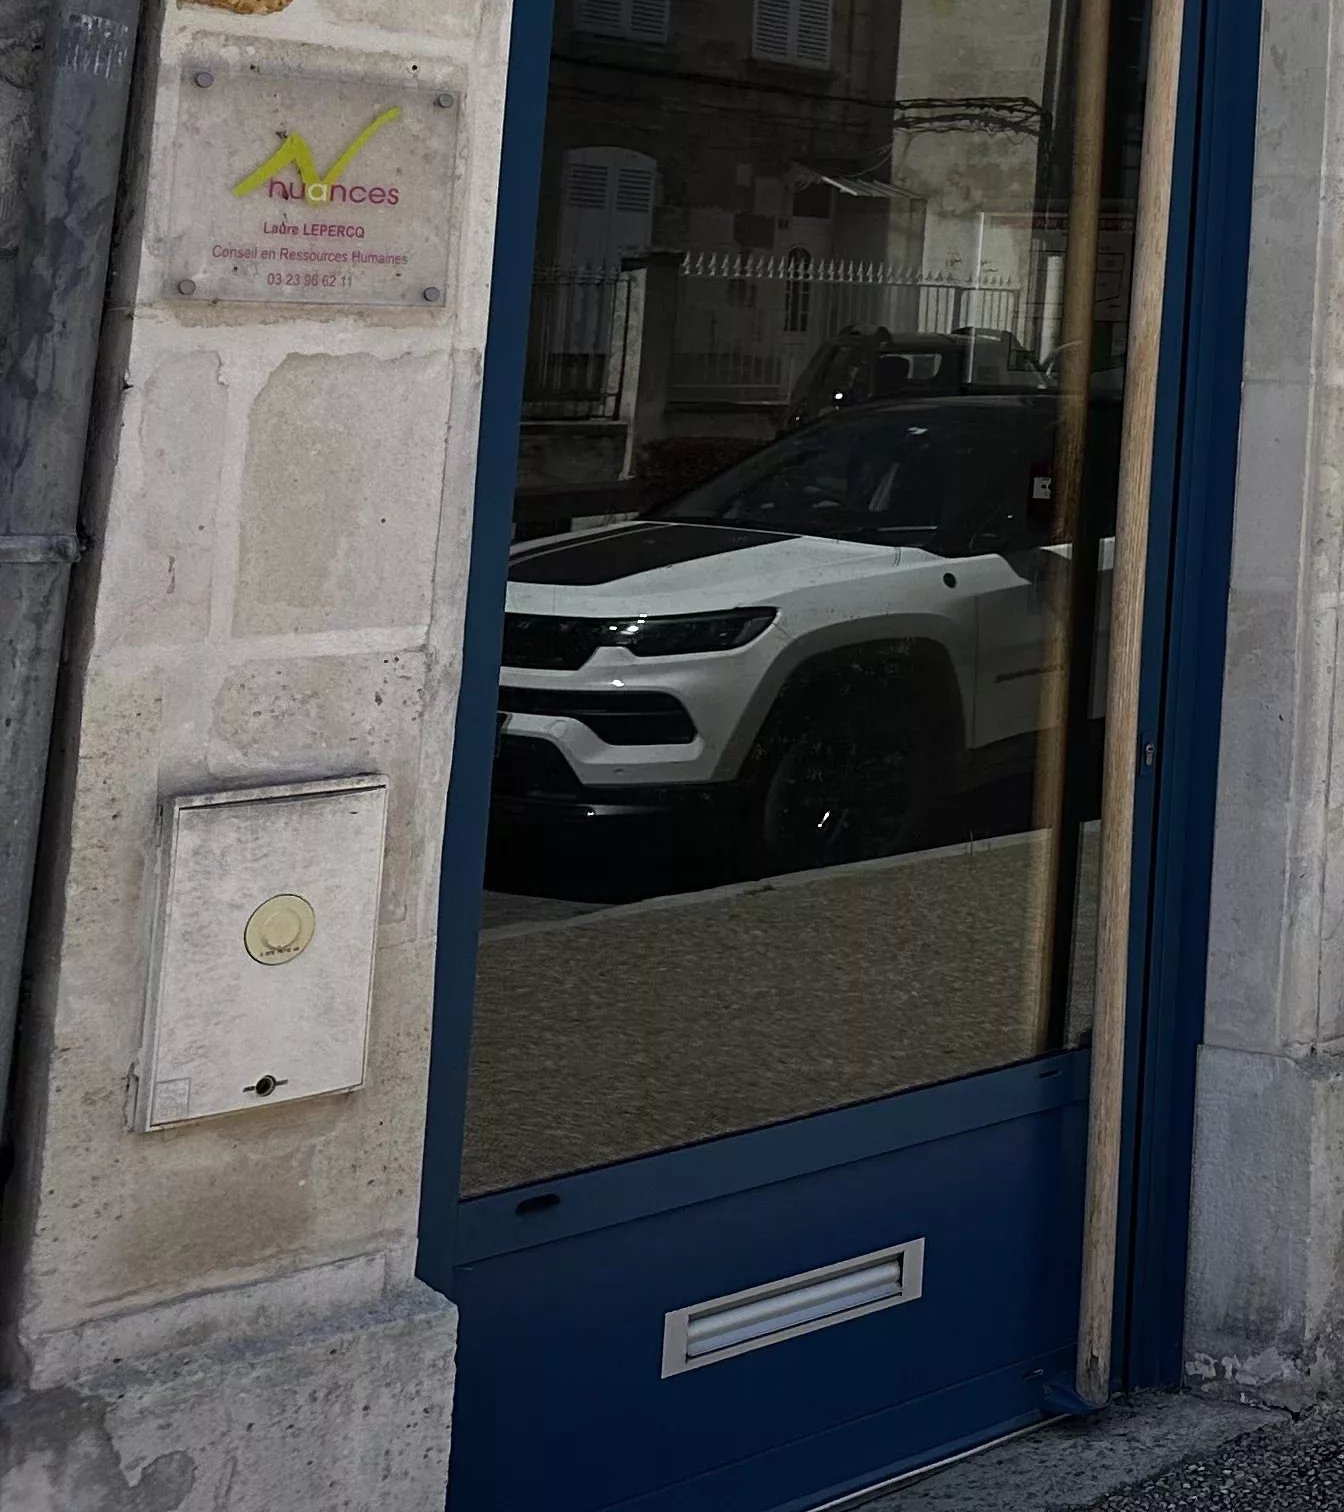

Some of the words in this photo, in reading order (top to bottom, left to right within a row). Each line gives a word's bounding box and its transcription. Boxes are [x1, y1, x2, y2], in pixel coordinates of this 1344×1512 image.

[267, 177, 400, 205] nuances
[263, 221, 299, 236] Laure
[302, 223, 365, 239] LEPERCQ
[212, 244, 257, 260] Conseil
[261, 248, 276, 260] en
[280, 247, 348, 263] Ressources
[351, 250, 408, 265] Humaines
[267, 272, 282, 286] 03
[286, 273, 300, 286] 23
[321, 274, 337, 287] 62
